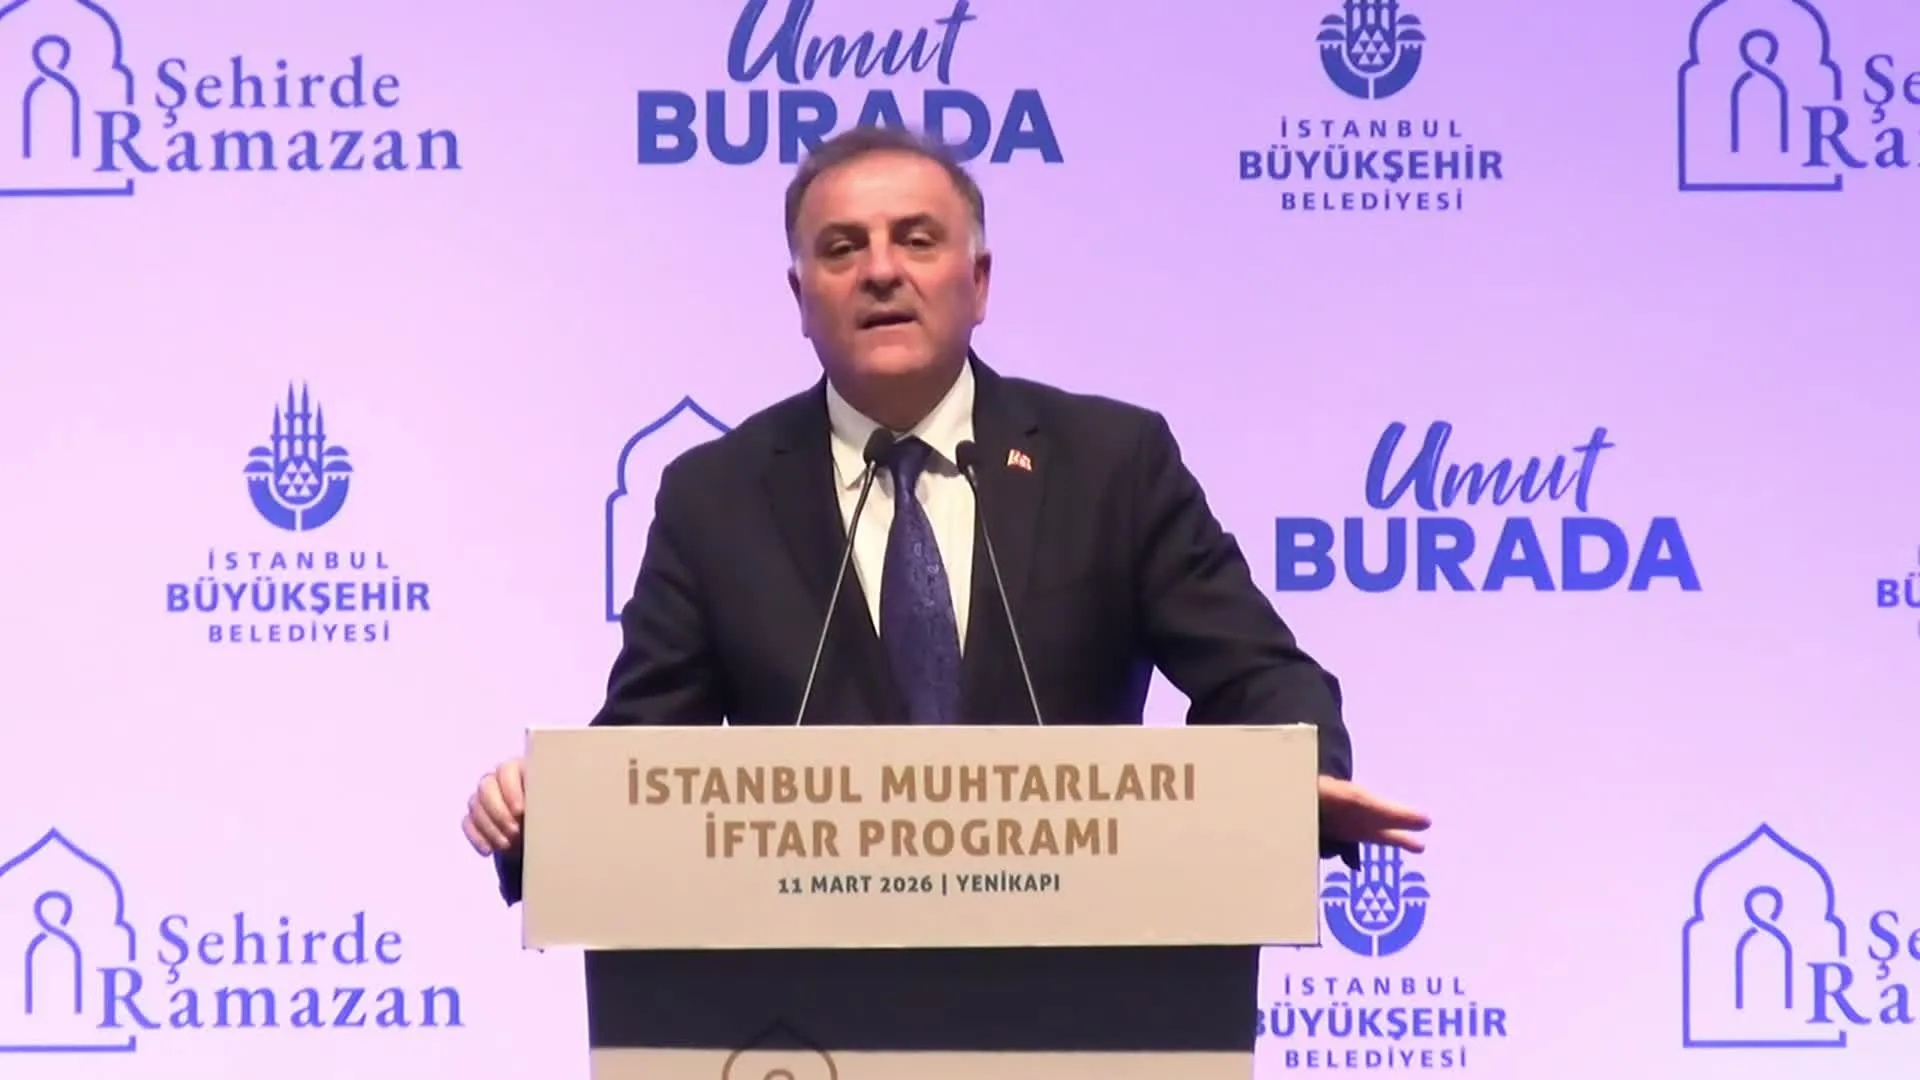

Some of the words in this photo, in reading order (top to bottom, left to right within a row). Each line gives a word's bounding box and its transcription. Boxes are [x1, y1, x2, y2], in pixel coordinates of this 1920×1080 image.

[728, 0, 977, 85] Umut
[155, 54, 399, 127] Şehirde
[95, 110, 462, 173] Ramazan
[1281, 116, 1461, 138] İSTANBUL
[1240, 144, 1503, 183] BÜYÜKŞEHİR
[1282, 189, 1462, 210] BELEDİYESİ
[1365, 420, 1615, 512] Umut
[209, 550, 388, 570] İSTANBUL
[1275, 517, 1702, 592] BURADA
[167, 576, 430, 615] BÜYÜKŞEHİR
[209, 621, 389, 643] BELEDİYESİ
[629, 758, 862, 805] İSTANBUL
[881, 764, 1194, 803] MUHTARLARI
[706, 812, 839, 858] İFTAR
[860, 818, 1118, 857] PROGRAMI
[779, 878, 802, 893] 11
[811, 875, 872, 893] MART
[881, 875, 932, 893] 2026
[957, 870, 1059, 892] YENİKAPI
[158, 912, 401, 984] Şehirde
[98, 967, 464, 1029] Ramazan
[1285, 974, 1464, 996] İSTANBUL
[1807, 962, 1914, 1025] Ra
[1286, 1046, 1465, 1068] BELEDİYESİ
